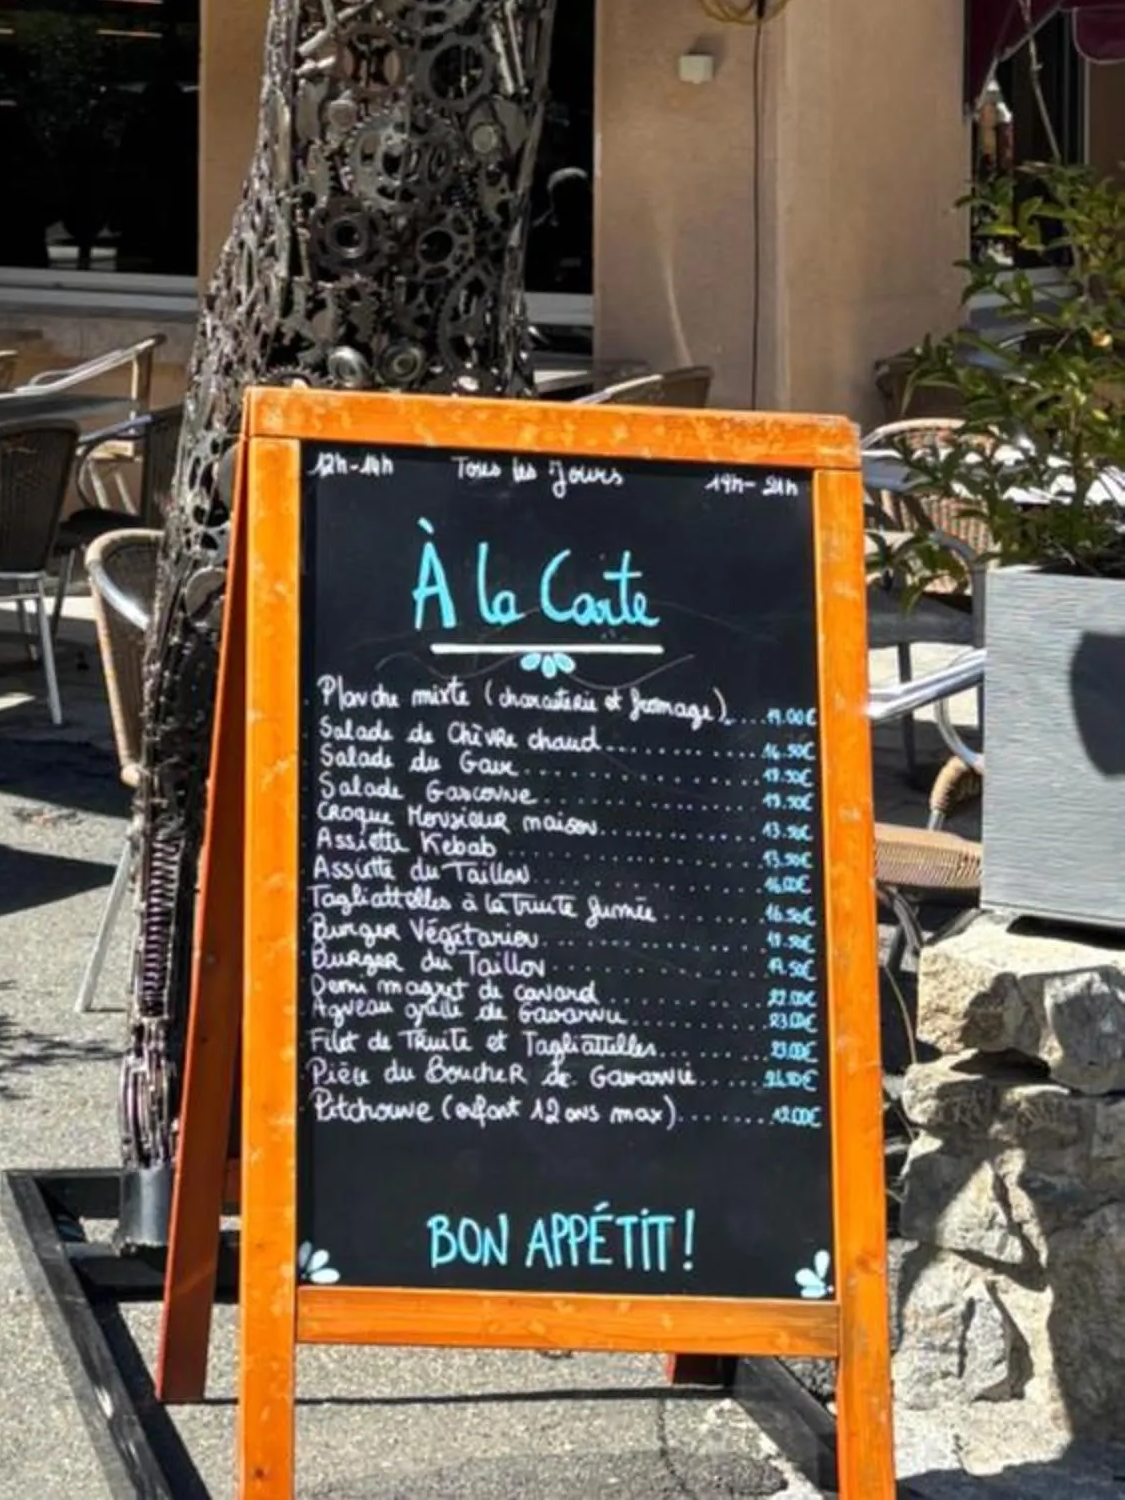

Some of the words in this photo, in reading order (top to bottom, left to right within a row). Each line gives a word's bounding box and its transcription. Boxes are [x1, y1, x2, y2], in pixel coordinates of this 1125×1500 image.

[450, 456, 502, 479] Tous
[512, 455, 538, 483] les
[412, 517, 457, 630] À
[476, 542, 526, 625] la
[540, 548, 661, 627] Carte
[316, 674, 401, 711] Planche
[412, 675, 471, 707] mixte
[604, 687, 623, 712] et
[319, 715, 394, 742] Salade
[406, 721, 435, 744] de
[527, 725, 601, 753] chaud
[319, 743, 395, 769] Salade
[409, 748, 442, 773] du
[318, 771, 405, 800] Salade
[316, 801, 395, 836] Croque
[407, 804, 512, 834] Monsieur
[523, 811, 598, 836] maison
[316, 826, 411, 853] Assiette
[420, 830, 498, 857] Kebab
[312, 854, 397, 881] Assiette
[409, 856, 441, 882] du
[441, 860, 531, 884] Taillon
[462, 892, 479, 912] à
[485, 893, 509, 915] la
[498, 893, 578, 918] Truite
[585, 894, 658, 929] fumée
[308, 912, 401, 949] Burger
[311, 940, 404, 978] Burger
[421, 952, 453, 973] du
[459, 950, 546, 977] Taillon
[311, 972, 367, 997] Demi
[377, 976, 470, 1005] magret
[478, 977, 504, 1001] de
[513, 979, 601, 1005] canard
[312, 997, 395, 1029] Agneau
[474, 1001, 508, 1023] de
[306, 1027, 361, 1054] Filet
[367, 1030, 393, 1053] de
[397, 1027, 474, 1053] Truite
[486, 1029, 509, 1054] et
[384, 1058, 416, 1085] du
[541, 1063, 573, 1089] de
[309, 1086, 435, 1123] Pitchoune
[530, 1097, 562, 1125] 12
[565, 1103, 600, 1123] ans
[610, 1093, 676, 1132] max)
[427, 1211, 509, 1269] BON
